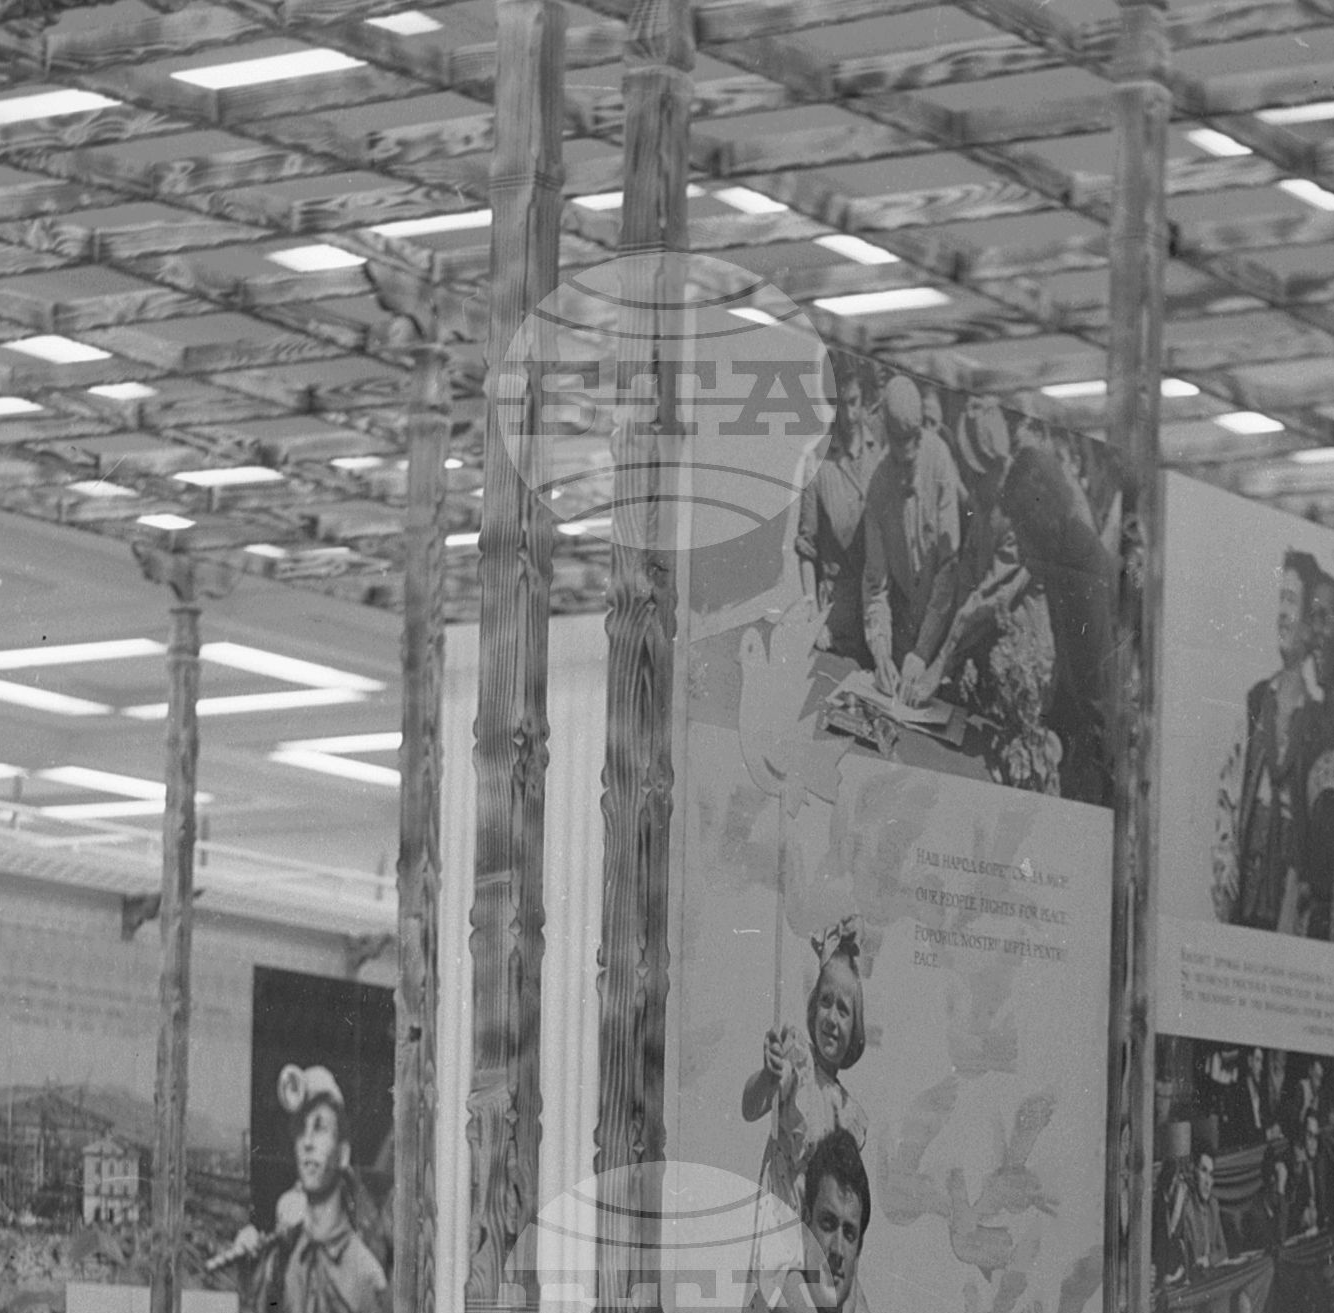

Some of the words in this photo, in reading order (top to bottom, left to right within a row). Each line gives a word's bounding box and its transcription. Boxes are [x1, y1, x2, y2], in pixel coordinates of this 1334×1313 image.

[915, 886, 938, 905] OUR
[939, 890, 977, 912] PEOPLE
[980, 897, 1016, 918] FIGHTS
[1019, 903, 1038, 920] FOR
